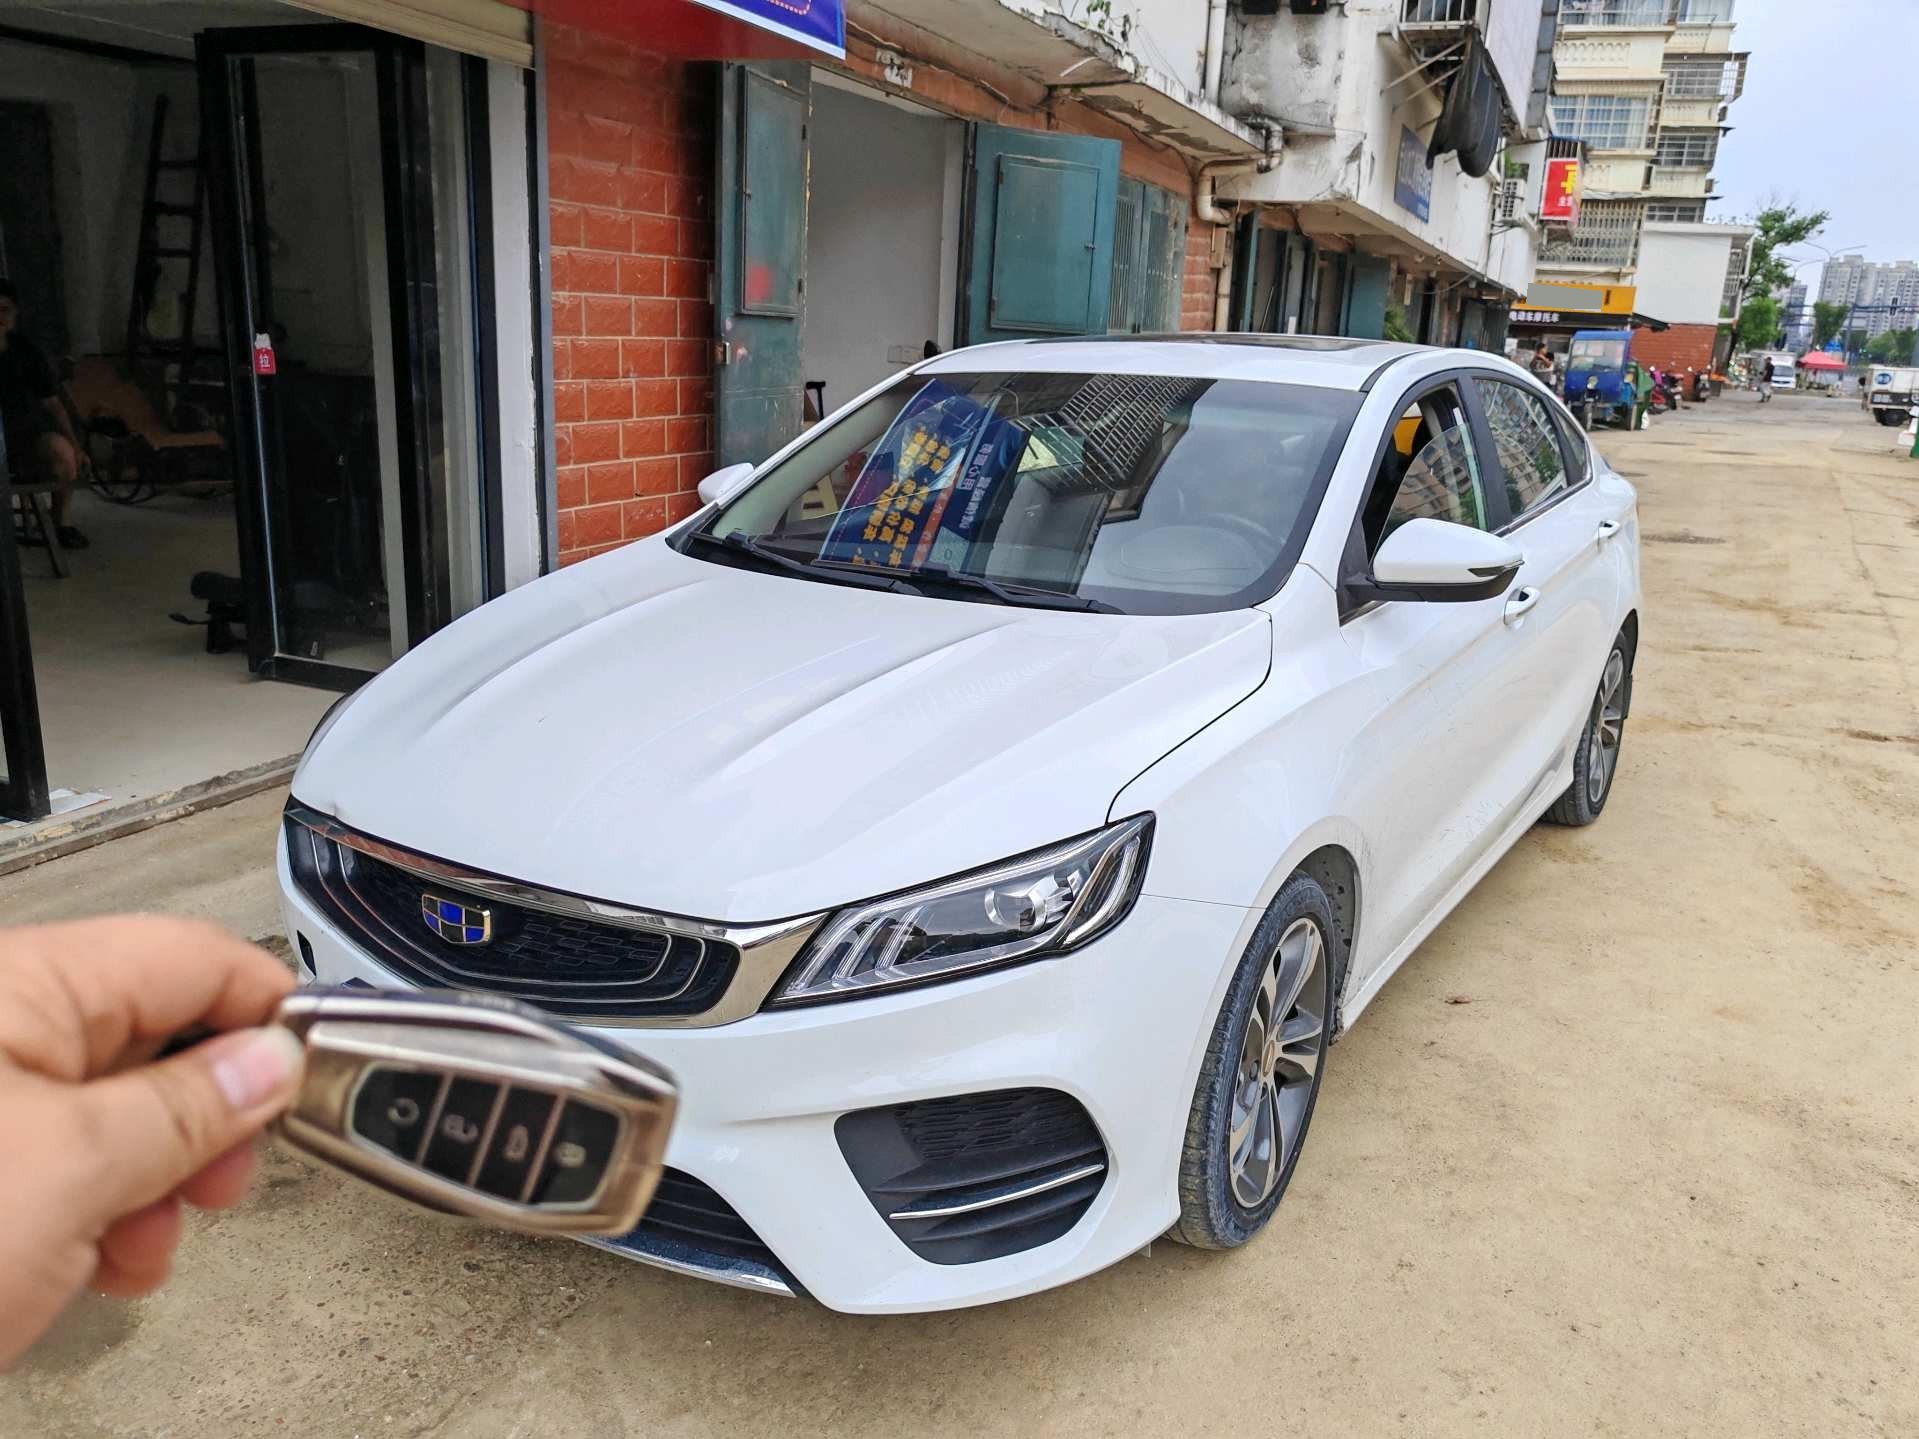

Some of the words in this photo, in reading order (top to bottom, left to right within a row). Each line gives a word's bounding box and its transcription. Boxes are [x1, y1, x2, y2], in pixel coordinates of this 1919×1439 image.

[1509, 311, 1560, 323] 电动车摩托车
